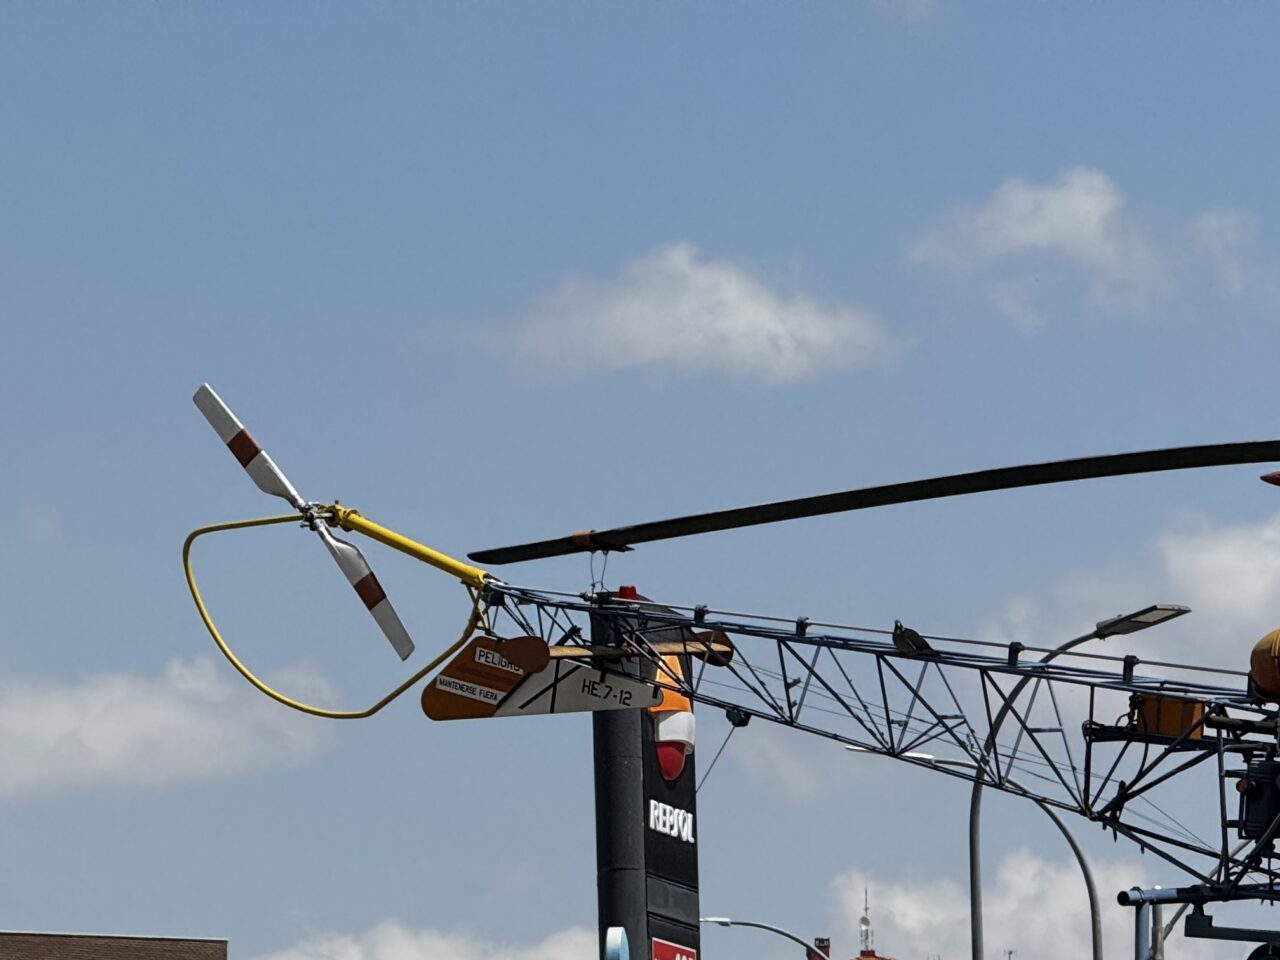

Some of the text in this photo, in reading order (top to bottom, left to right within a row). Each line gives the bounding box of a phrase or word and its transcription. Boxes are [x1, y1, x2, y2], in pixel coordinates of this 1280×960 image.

[439, 678, 498, 701] MANTENERSE FUERA
[650, 799, 695, 843] REPSOL
